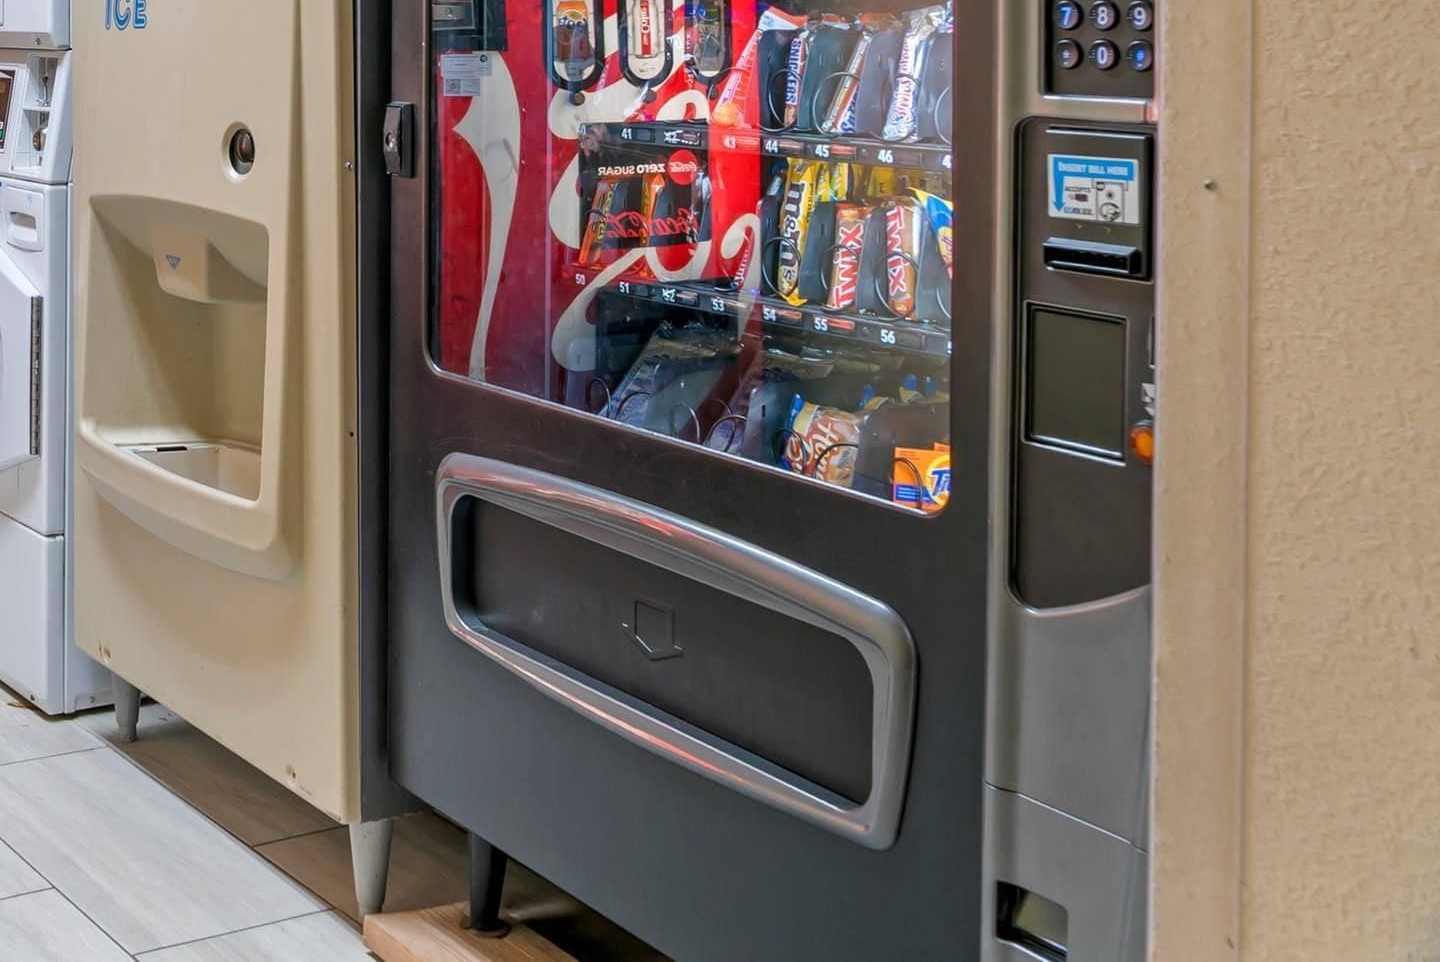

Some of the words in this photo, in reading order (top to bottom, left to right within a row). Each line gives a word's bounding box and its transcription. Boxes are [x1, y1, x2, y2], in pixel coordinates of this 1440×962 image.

[1061, 7, 1072, 26] 7
[1097, 6, 1108, 26] 8
[1133, 6, 1146, 26] 9
[1097, 46, 1108, 64] 0
[786, 38, 802, 105] SNICKERS
[621, 128, 632, 140] 41
[724, 136, 736, 149] 43
[765, 140, 779, 153] 44
[815, 145, 829, 158] 45
[878, 149, 893, 164] 46
[942, 154, 952, 169] 4
[887, 205, 907, 295] TWIX
[833, 222, 864, 311] TWIX
[575, 273, 586, 285] 50
[619, 281, 630, 294] 51
[712, 298, 725, 312] 53
[763, 308, 776, 321] 54
[814, 318, 828, 331] 55
[880, 329, 895, 343] 56
